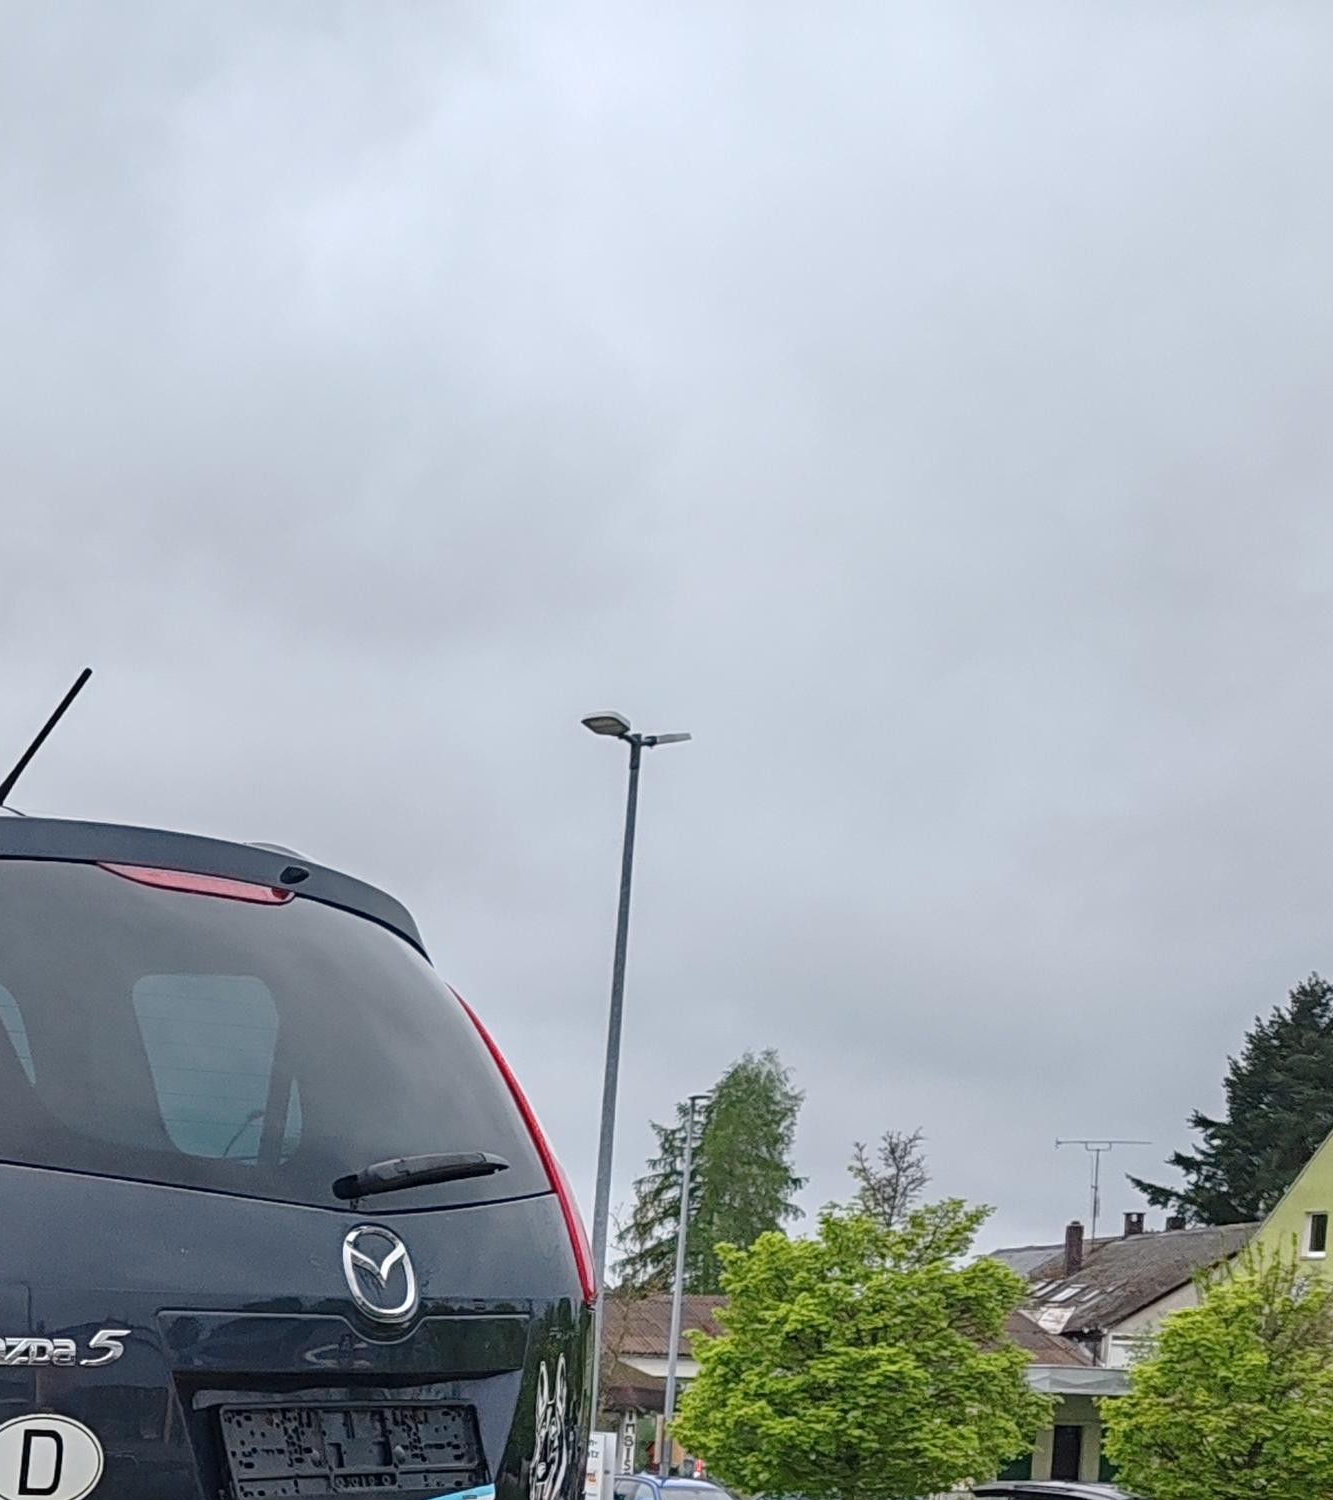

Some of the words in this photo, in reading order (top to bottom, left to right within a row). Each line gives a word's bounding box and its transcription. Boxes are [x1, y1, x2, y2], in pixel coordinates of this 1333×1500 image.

[80, 1329, 132, 1366] 5
[18, 1429, 64, 1495] D
[624, 1410, 635, 1475] IMBIS
